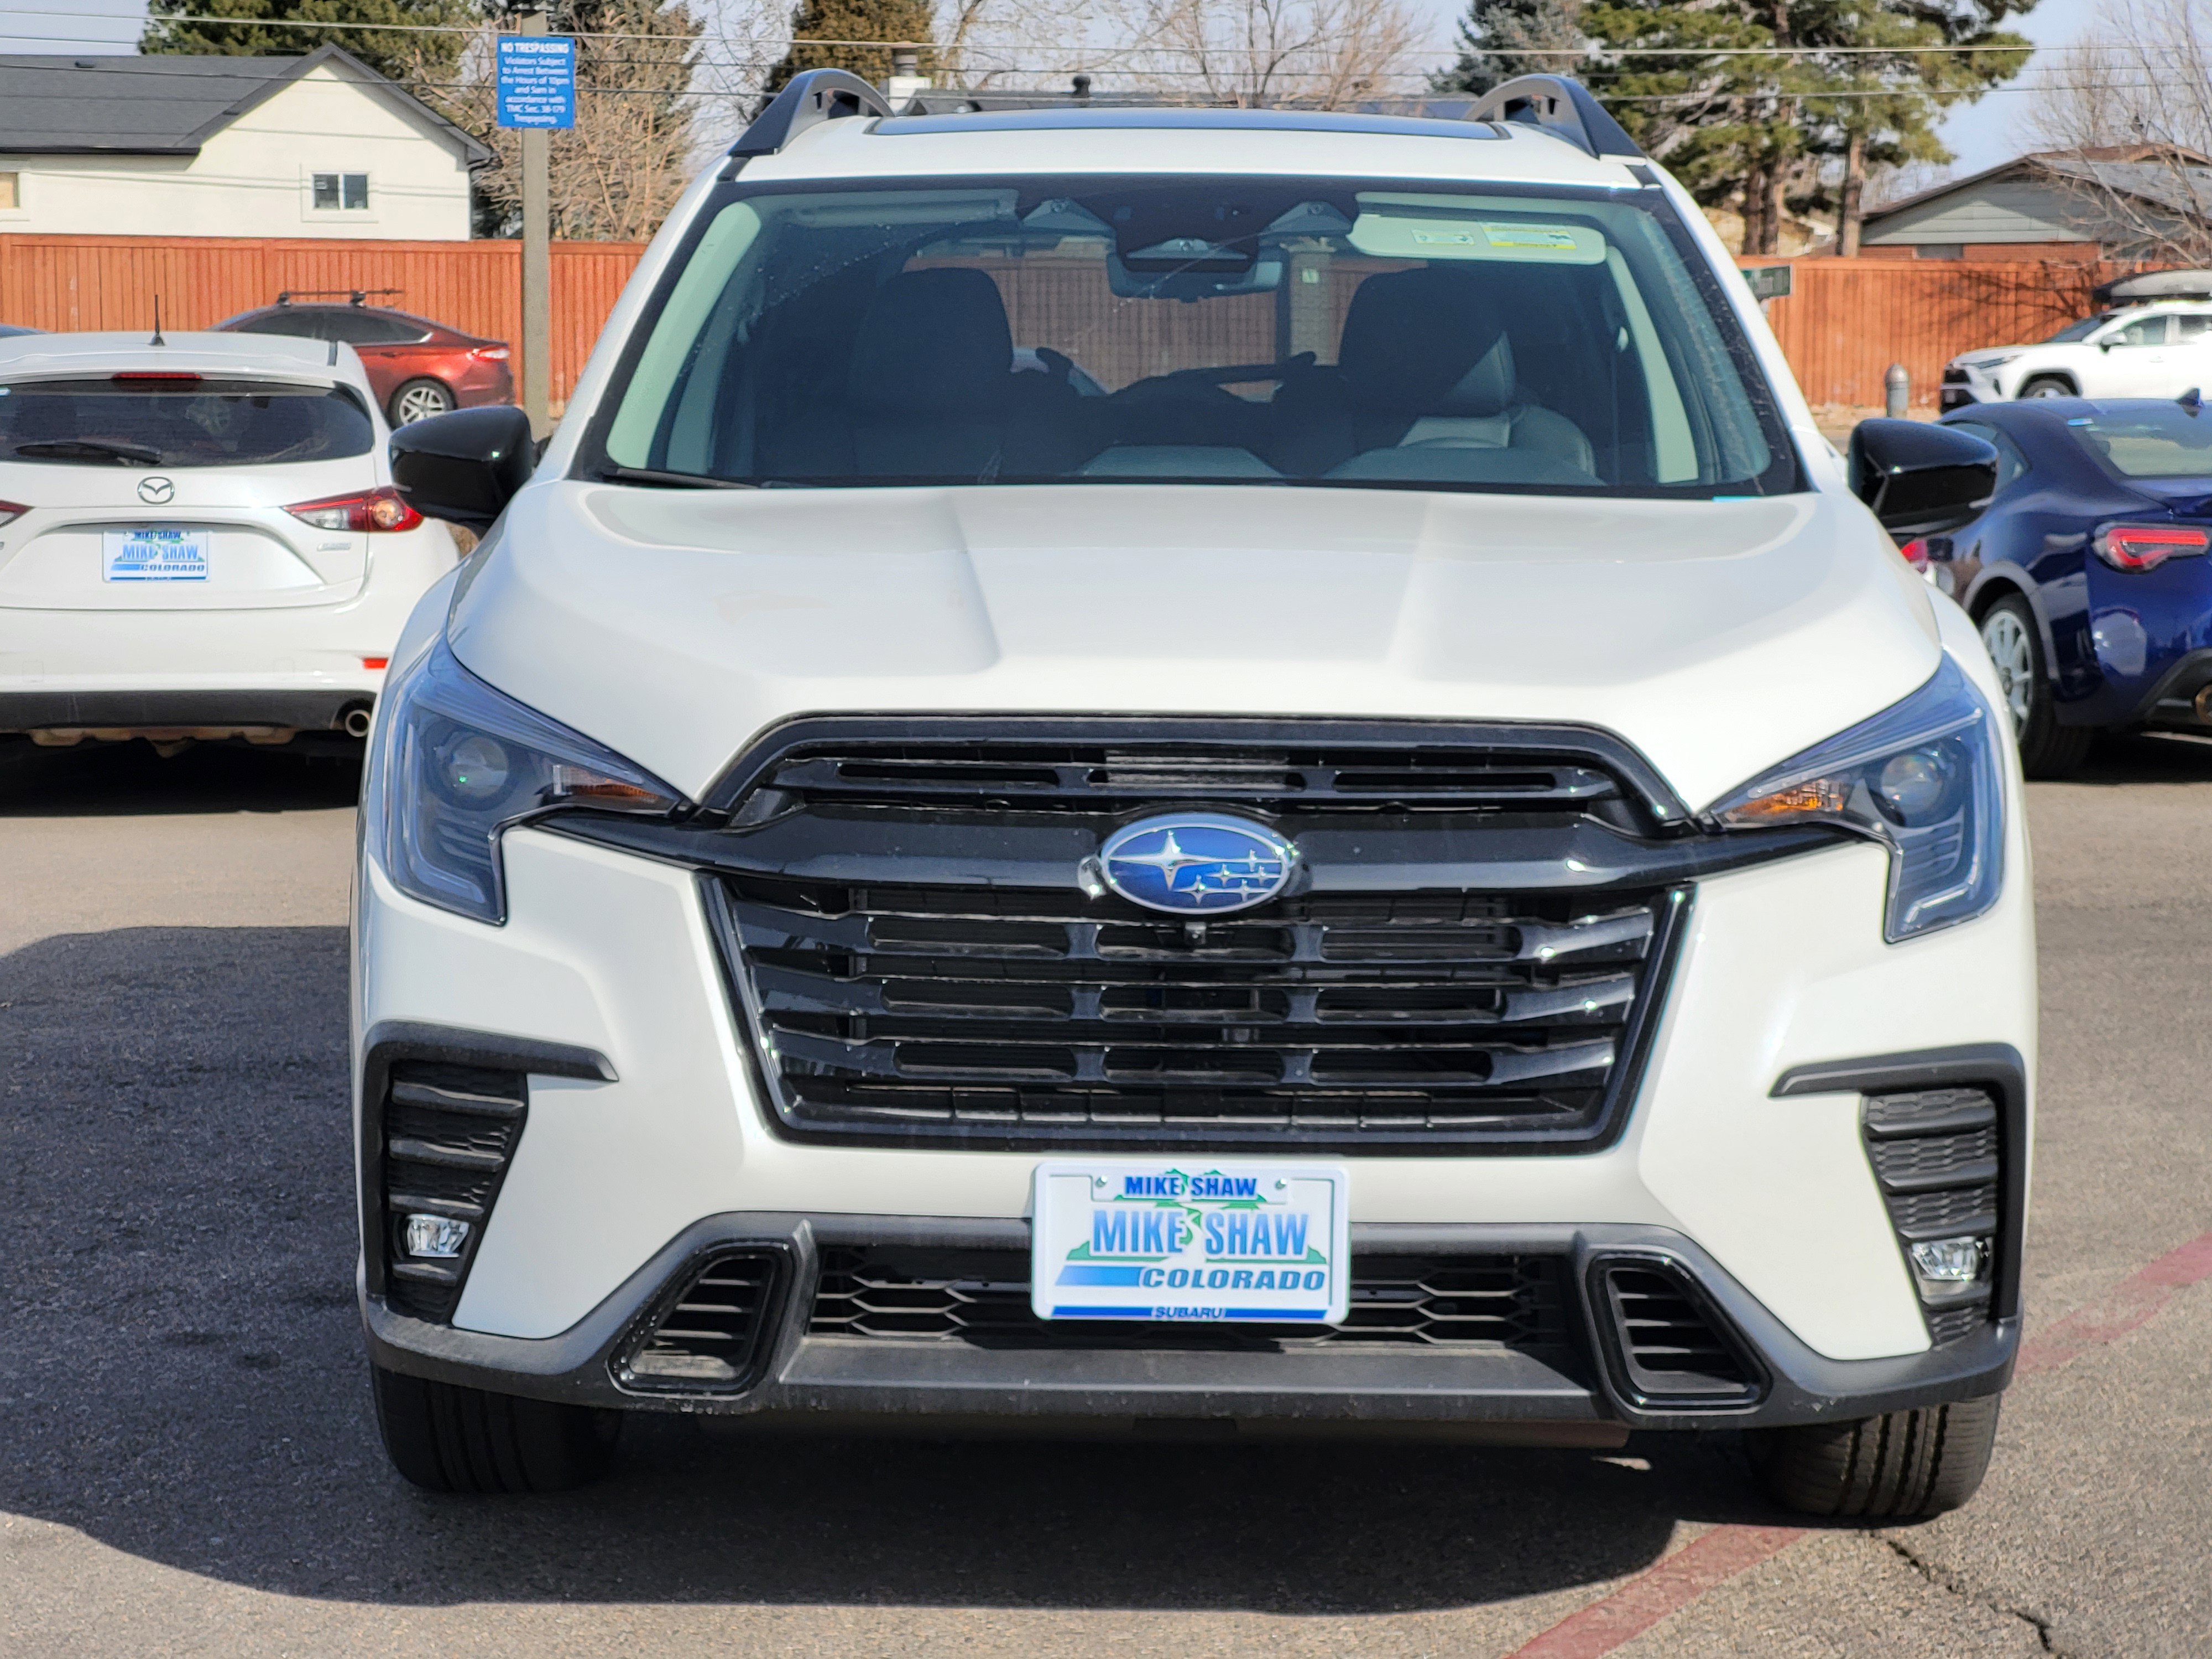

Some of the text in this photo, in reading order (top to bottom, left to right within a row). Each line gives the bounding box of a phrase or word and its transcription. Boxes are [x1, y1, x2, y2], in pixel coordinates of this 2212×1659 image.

[500, 42, 569, 54] NO TRESPASSING
[504, 56, 566, 66] Violators Subject
[512, 66, 534, 75] Arrest
[535, 67, 568, 75] Between
[538, 76, 547, 84] of
[134, 531, 181, 539] MIKE SHAW
[123, 544, 198, 560] MIKE SHAW
[1125, 1176, 1256, 1197] MIKE SHAW
[1093, 1209, 1309, 1256] MIKE SHAW
[1142, 1268, 1325, 1291] COLORADO
[1155, 1307, 1224, 1319] SUBARU
